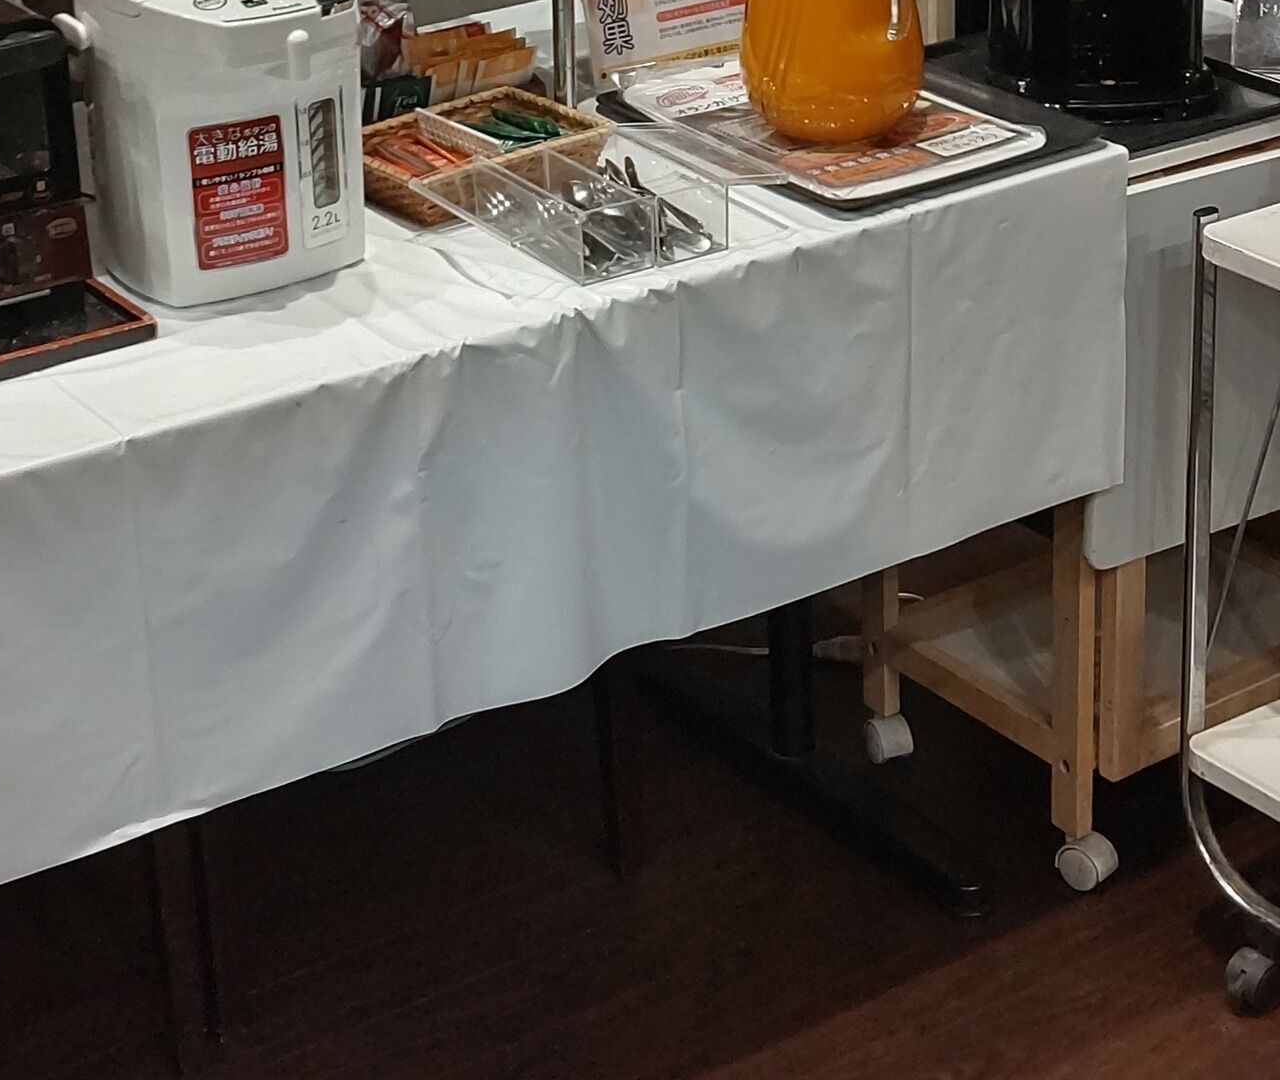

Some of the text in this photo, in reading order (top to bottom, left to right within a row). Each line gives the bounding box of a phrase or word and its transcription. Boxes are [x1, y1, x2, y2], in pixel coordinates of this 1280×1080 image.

[394, 94, 418, 108] Tea
[193, 132, 279, 166] 電動給湯
[311, 210, 342, 232] 2.2L
